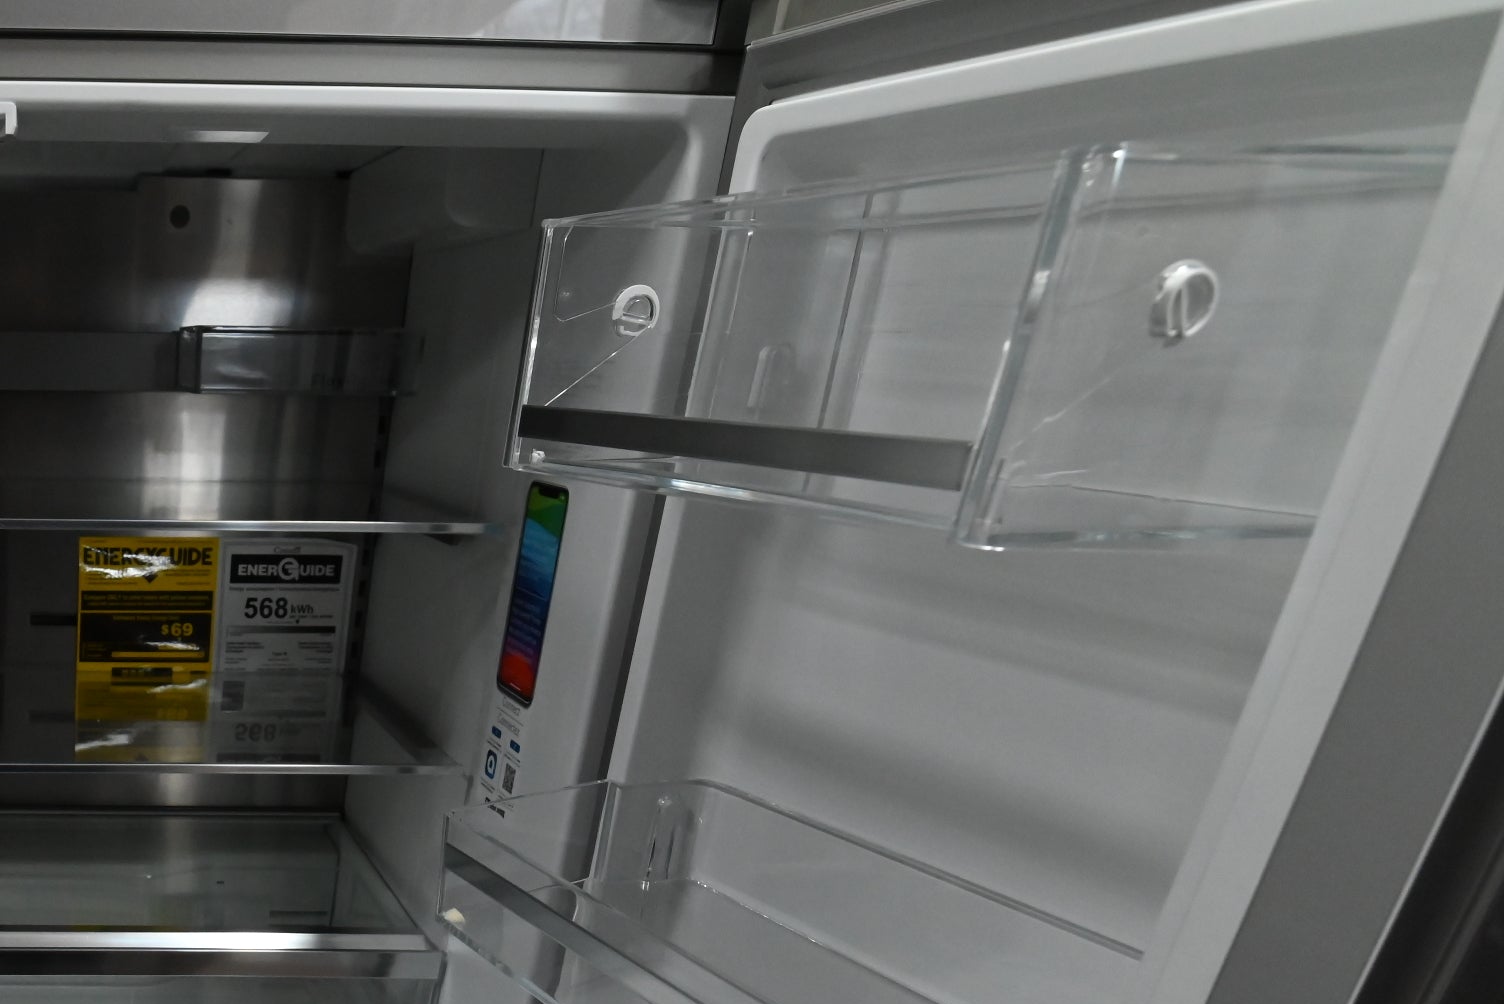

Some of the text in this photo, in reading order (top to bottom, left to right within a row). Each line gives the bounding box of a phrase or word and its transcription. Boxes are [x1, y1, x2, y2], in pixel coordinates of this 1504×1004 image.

[83, 546, 213, 566] ENERGYUIDE
[237, 557, 336, 581] ENERGUIDE
[244, 597, 288, 619] 568
[290, 604, 314, 615] kWh
[160, 622, 194, 637] $69
